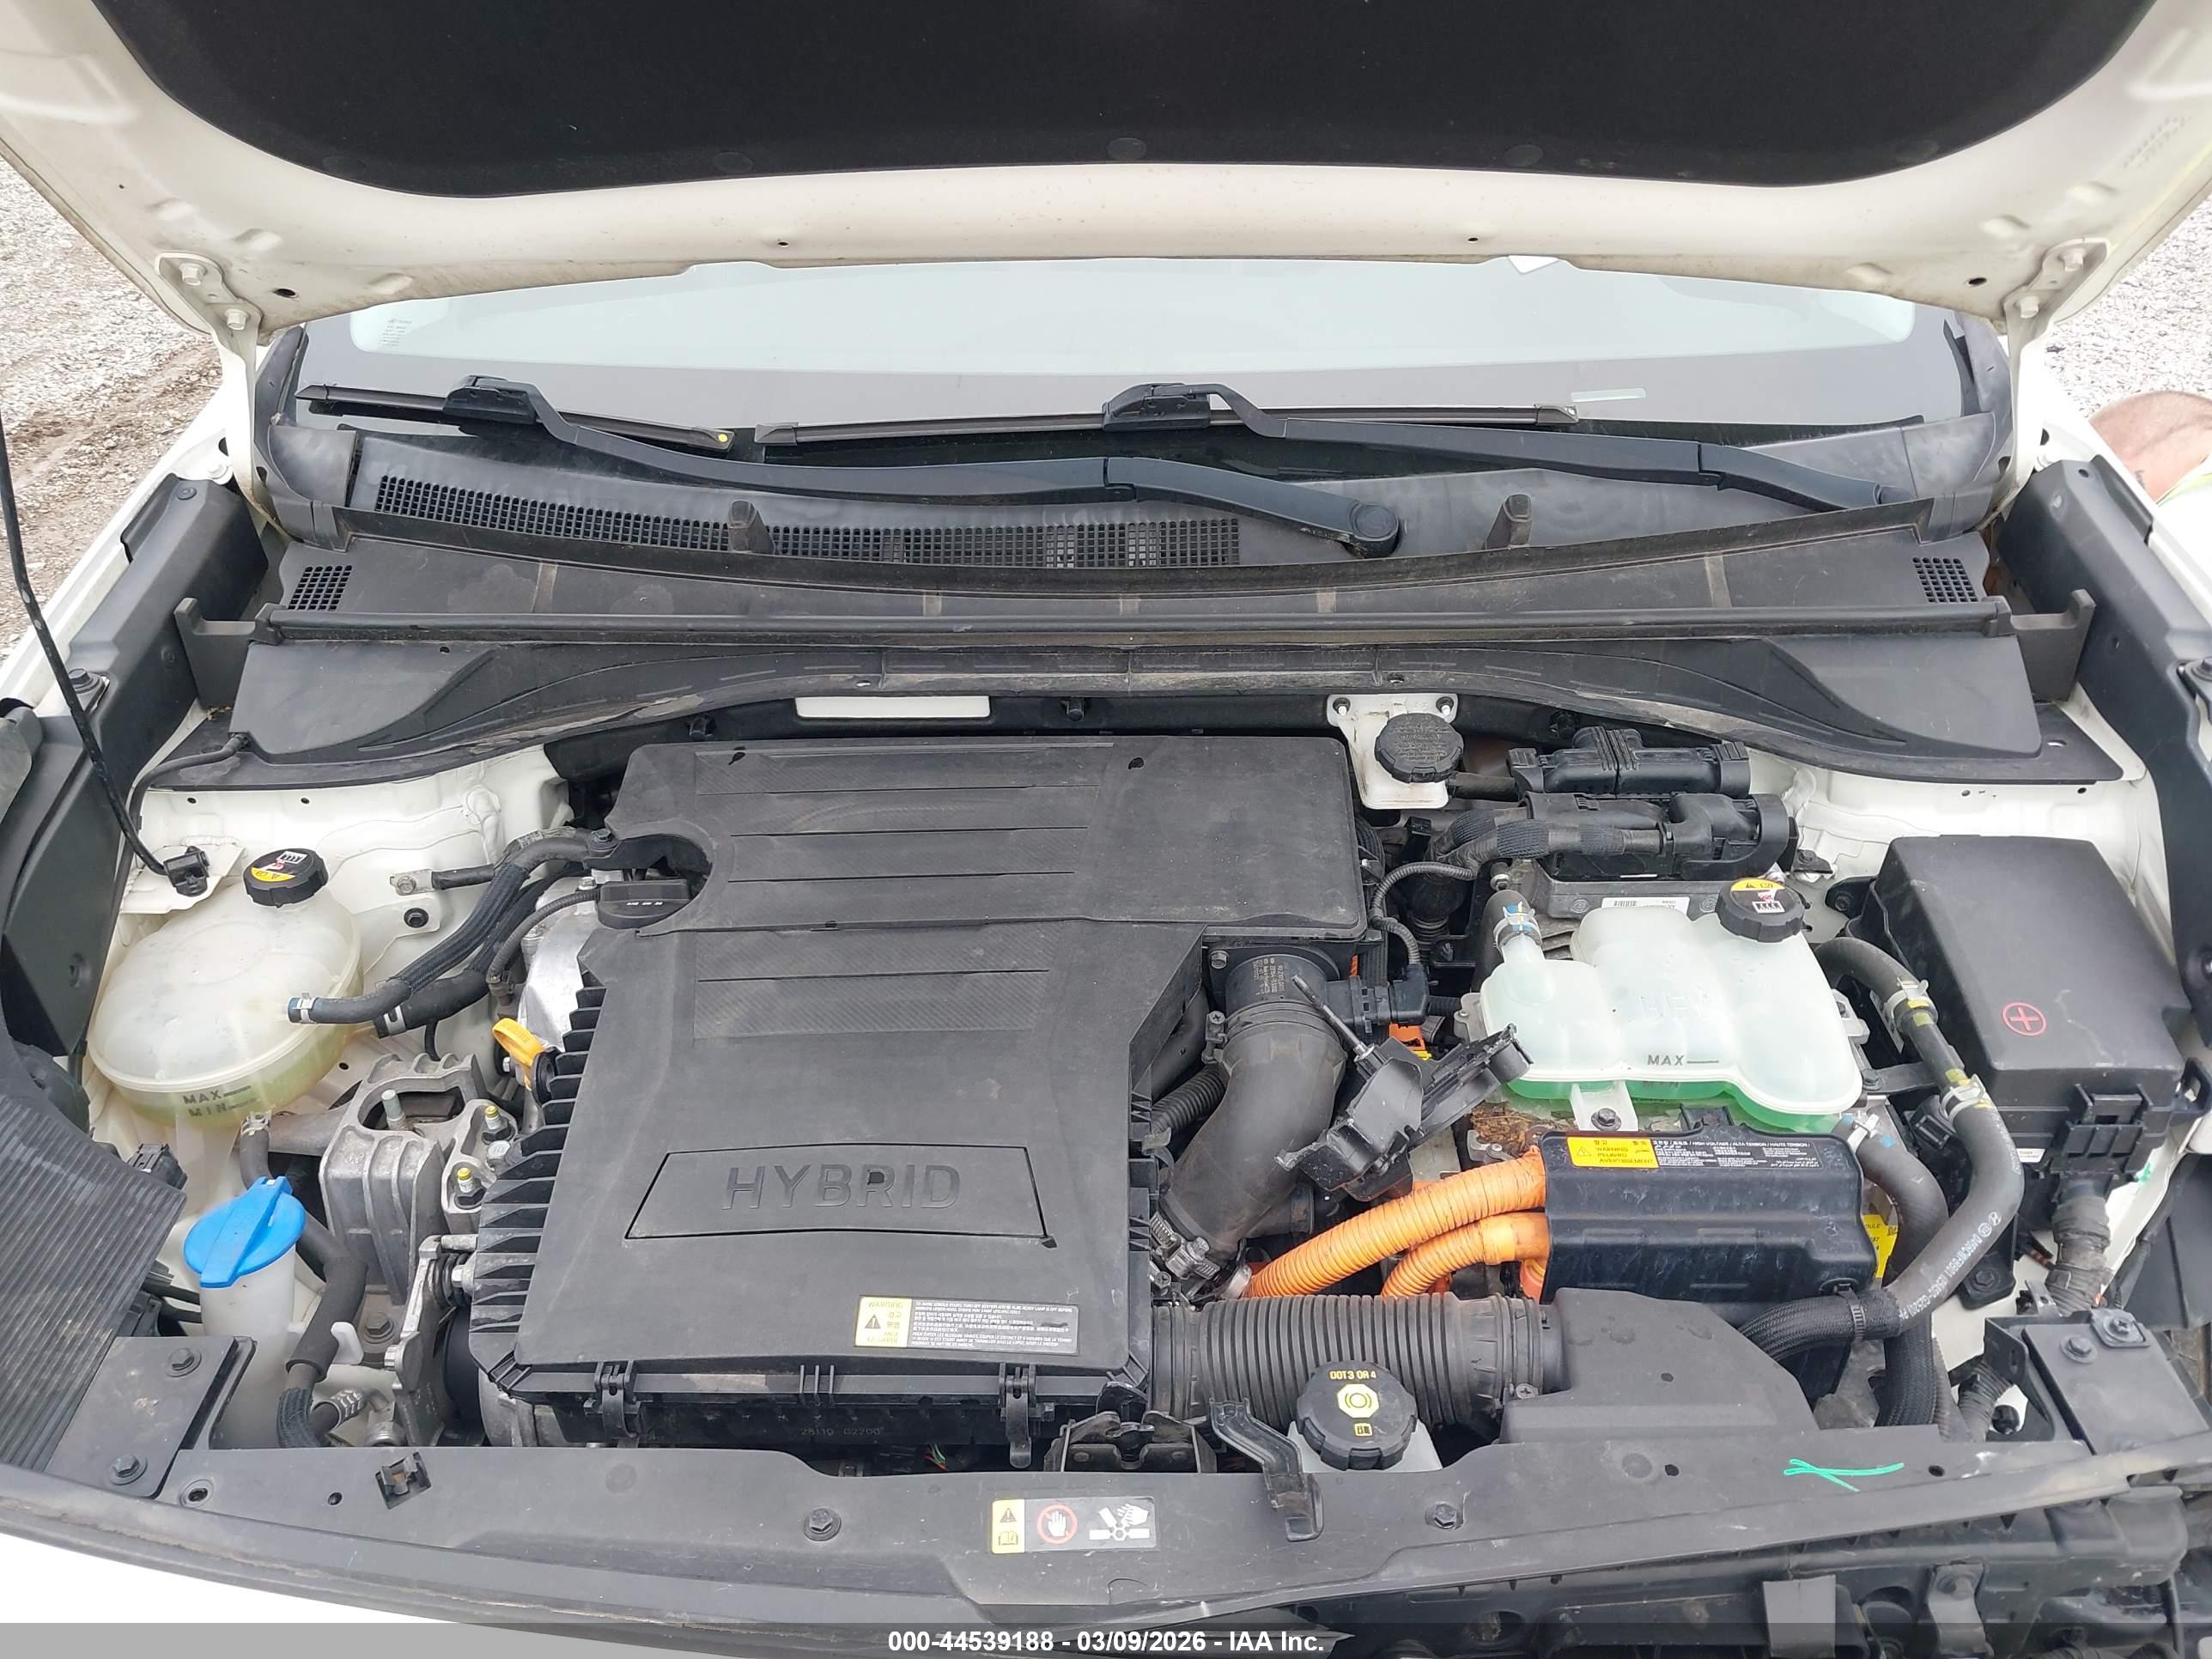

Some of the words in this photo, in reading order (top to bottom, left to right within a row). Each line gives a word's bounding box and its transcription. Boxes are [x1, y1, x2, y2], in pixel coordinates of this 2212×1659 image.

[1648, 1054, 1684, 1066] MAX
[182, 1090, 222, 1104] MAX
[188, 1103, 227, 1117] MIN
[721, 1164, 961, 1210] HYBRID
